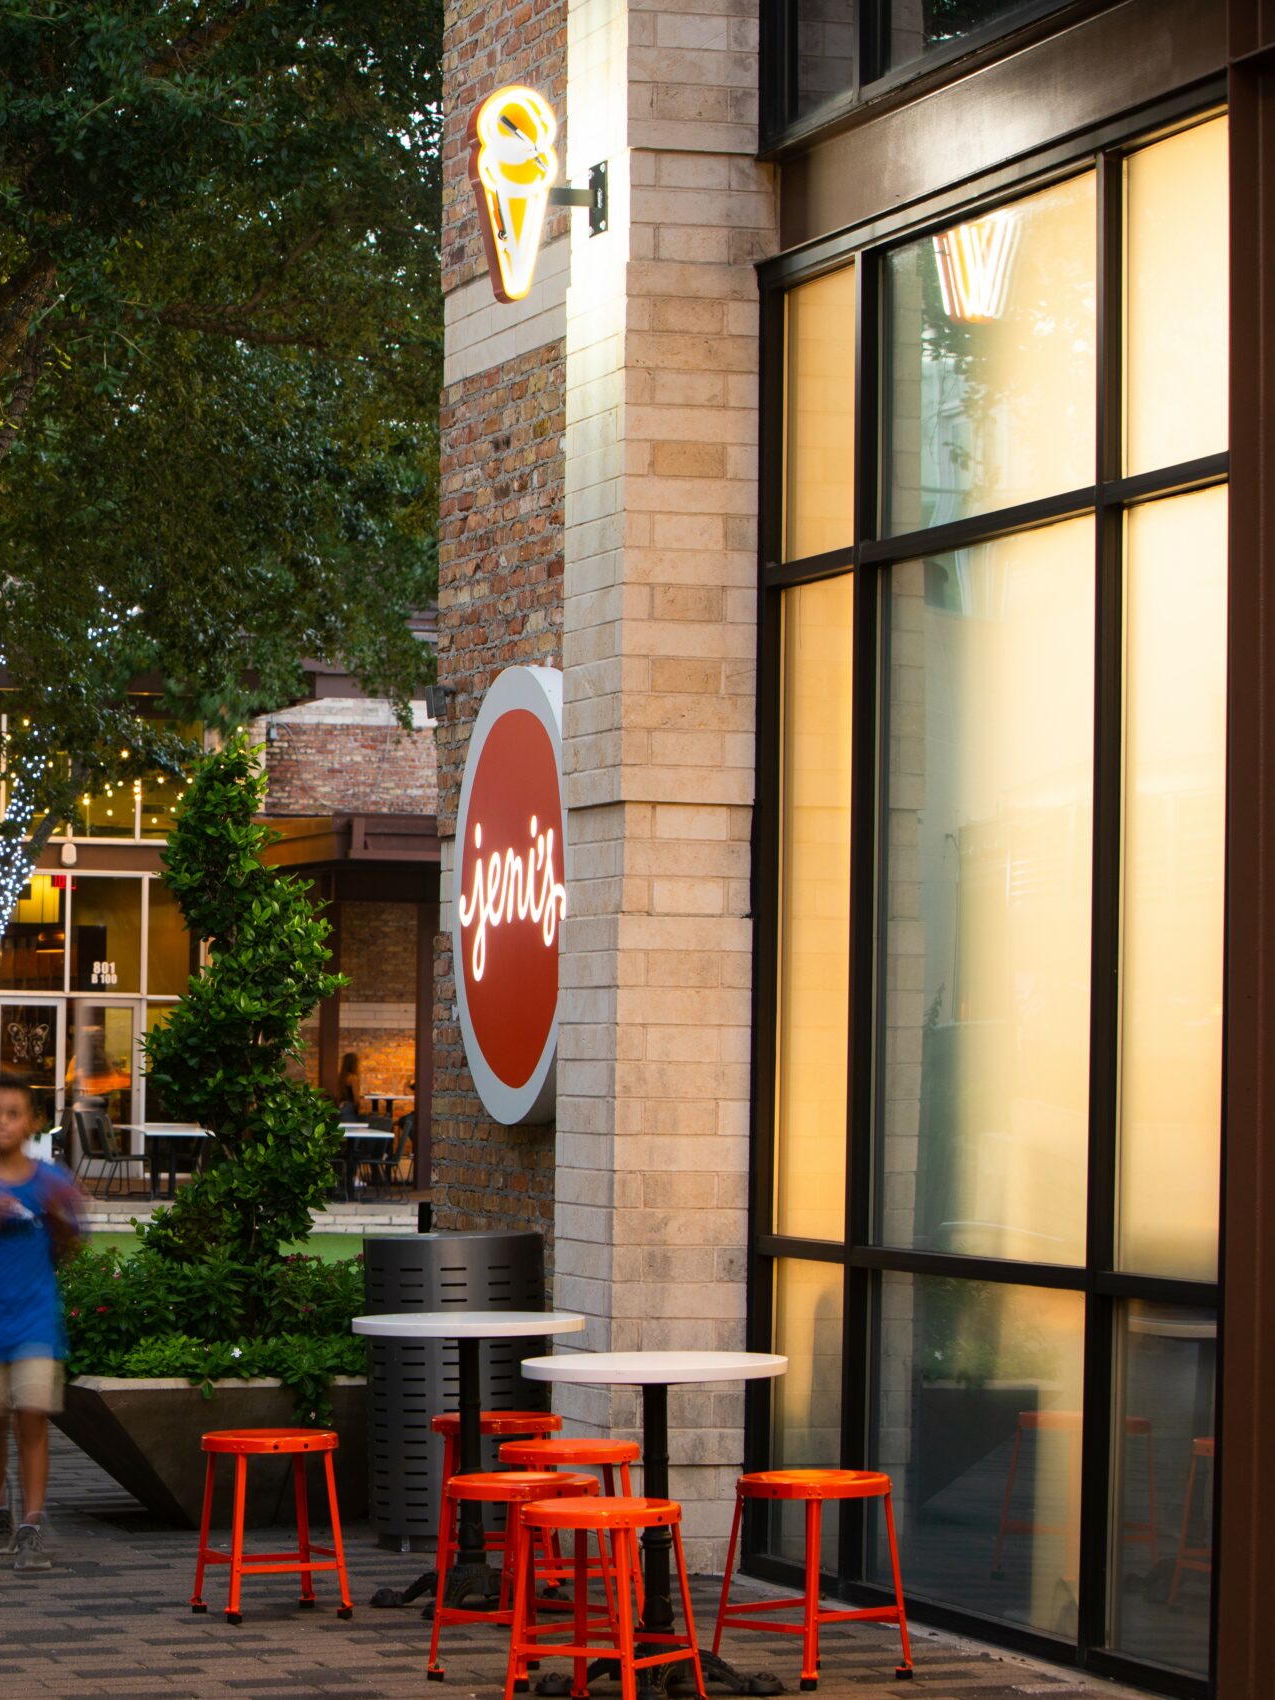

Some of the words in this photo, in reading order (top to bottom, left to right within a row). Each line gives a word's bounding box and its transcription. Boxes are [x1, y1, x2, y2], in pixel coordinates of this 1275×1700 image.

[459, 815, 567, 982] jeni's
[93, 961, 116, 974] 801
[100, 974, 118, 984] 100
